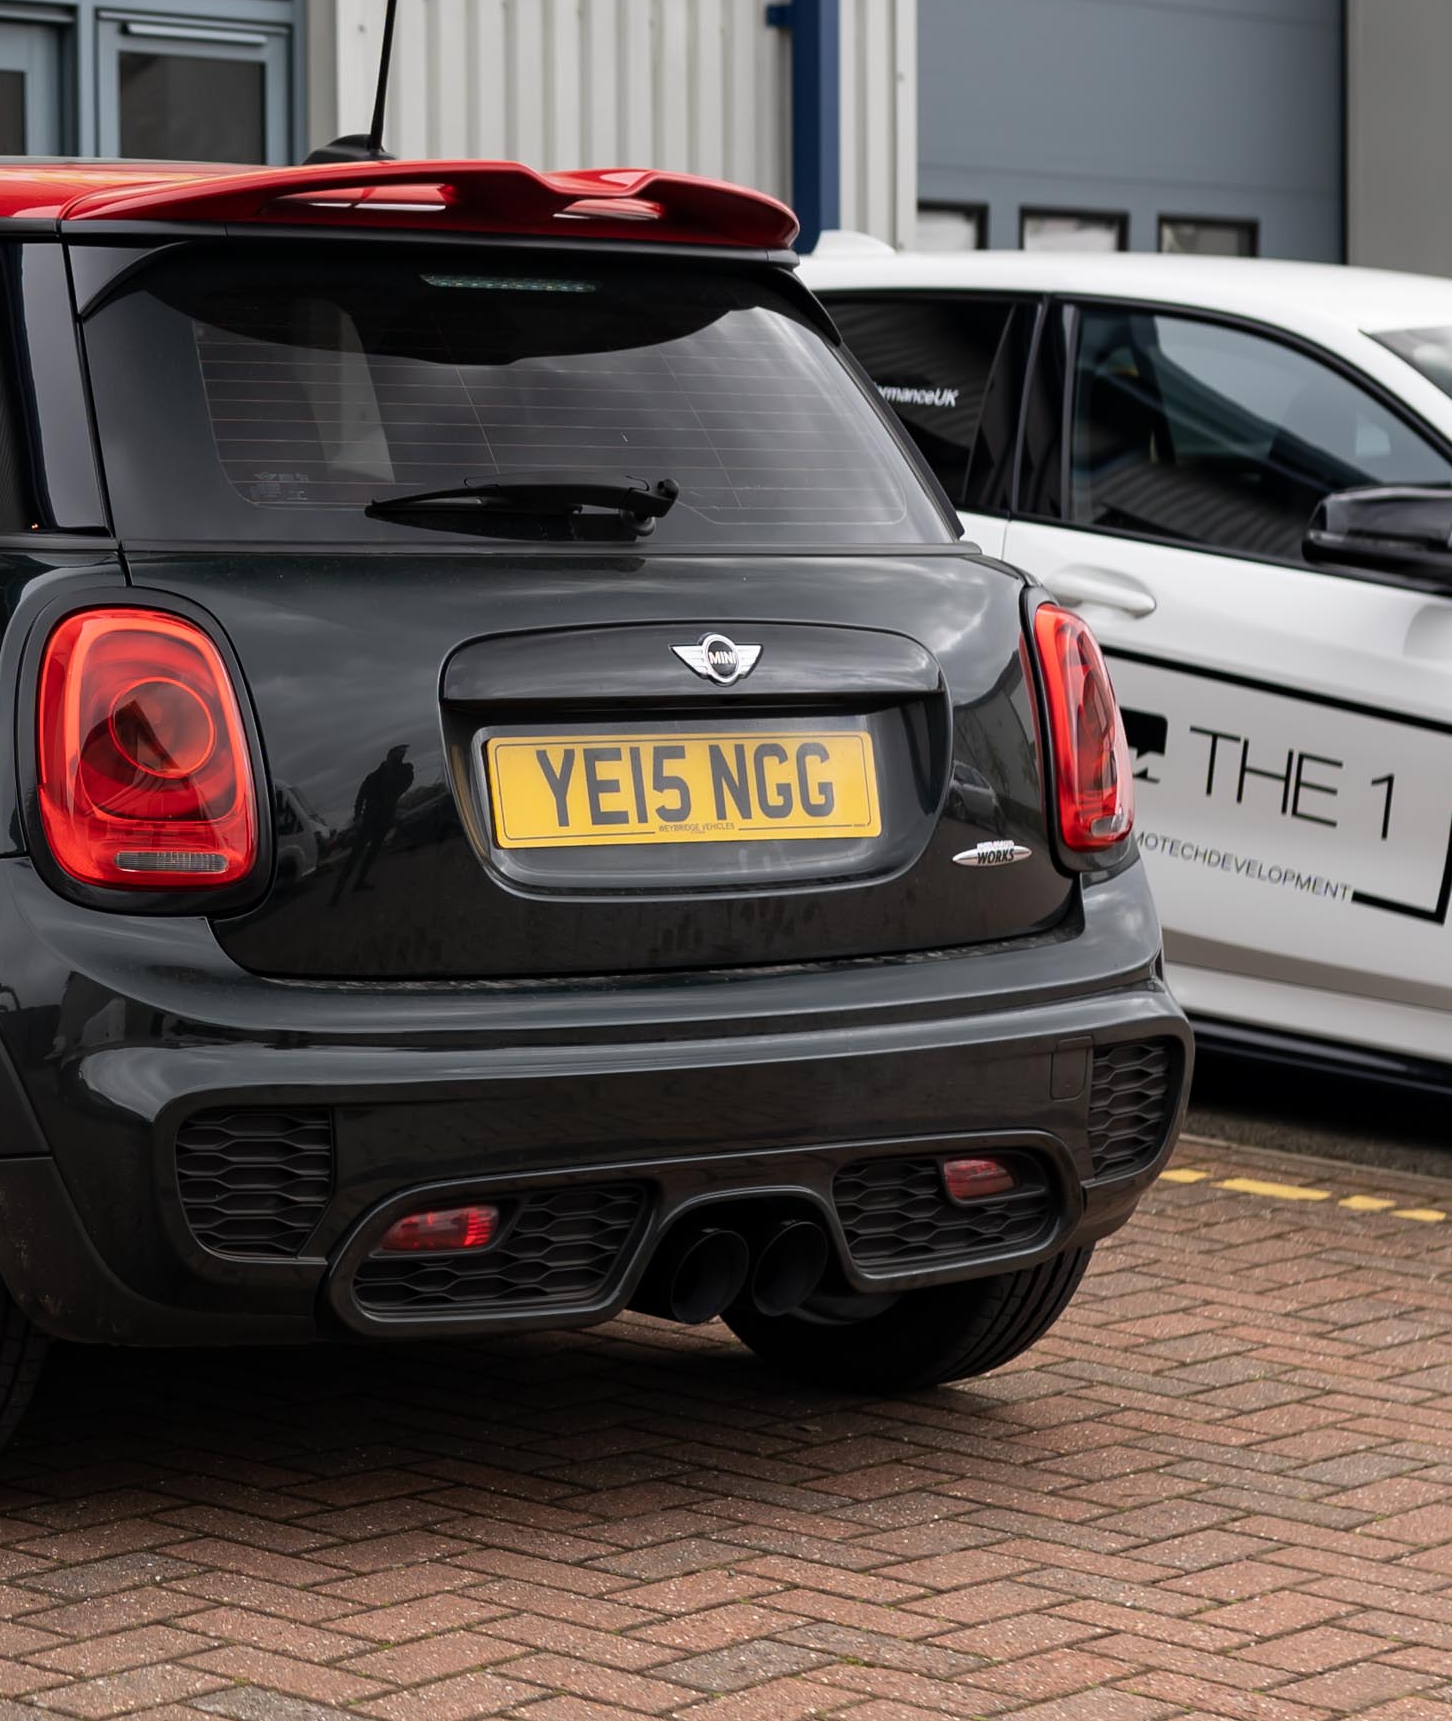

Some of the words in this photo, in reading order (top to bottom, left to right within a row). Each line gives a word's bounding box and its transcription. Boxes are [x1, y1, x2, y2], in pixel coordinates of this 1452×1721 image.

[708, 650, 738, 665] MINI
[536, 743, 692, 828] YE15
[710, 742, 836, 821] NGG
[1189, 725, 1343, 828] THE
[1371, 772, 1395, 841] 1
[702, 822, 735, 831] VEHICLES
[977, 848, 1015, 865] WORKS
